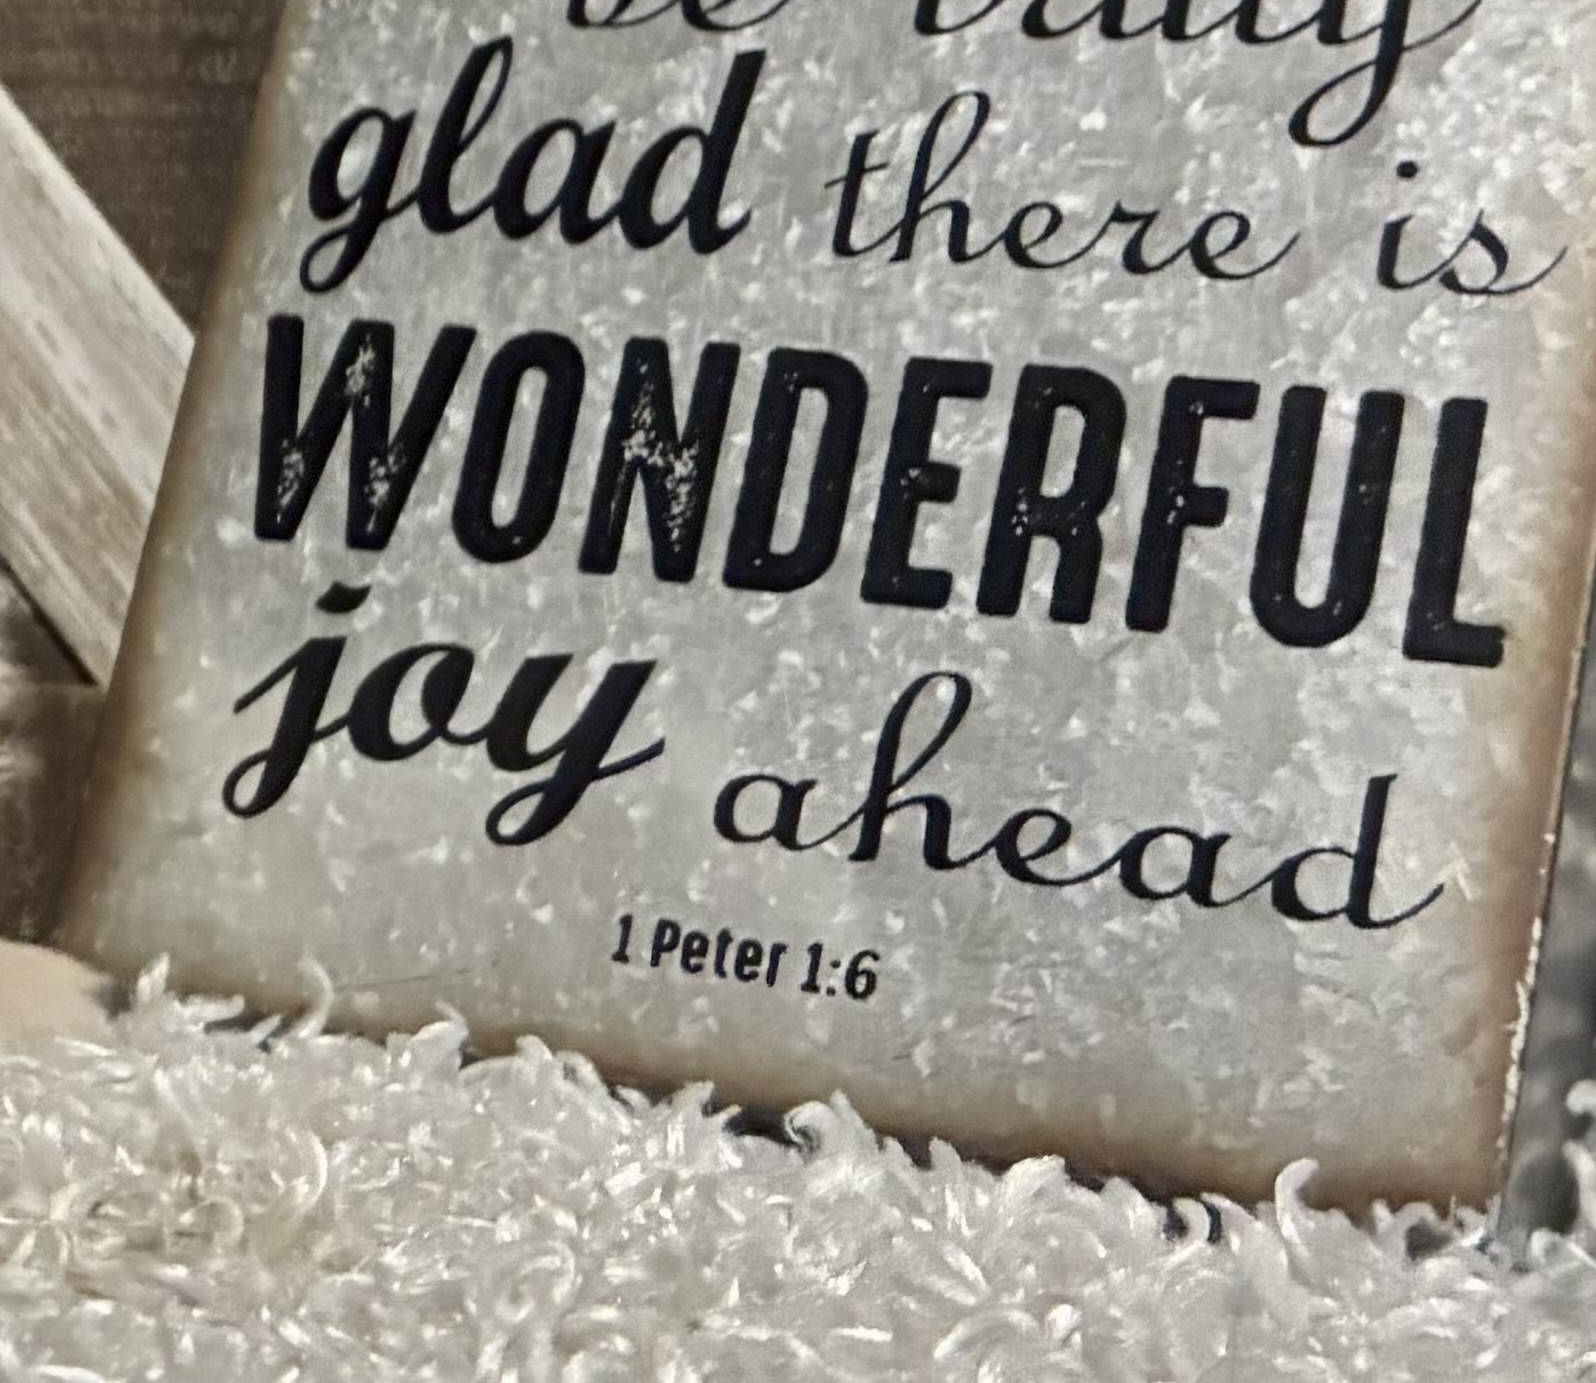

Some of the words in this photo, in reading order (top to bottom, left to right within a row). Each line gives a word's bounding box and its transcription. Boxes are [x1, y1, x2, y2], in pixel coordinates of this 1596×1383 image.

[298, 37, 767, 293] glad
[824, 90, 1301, 282] there
[1375, 160, 1568, 298] is
[253, 313, 1506, 668] WONDERFUL
[221, 583, 665, 848] joy
[712, 671, 1445, 930] ahead
[610, 913, 634, 964] 1
[649, 918, 789, 987] Peter
[800, 942, 880, 1001] 1:6
